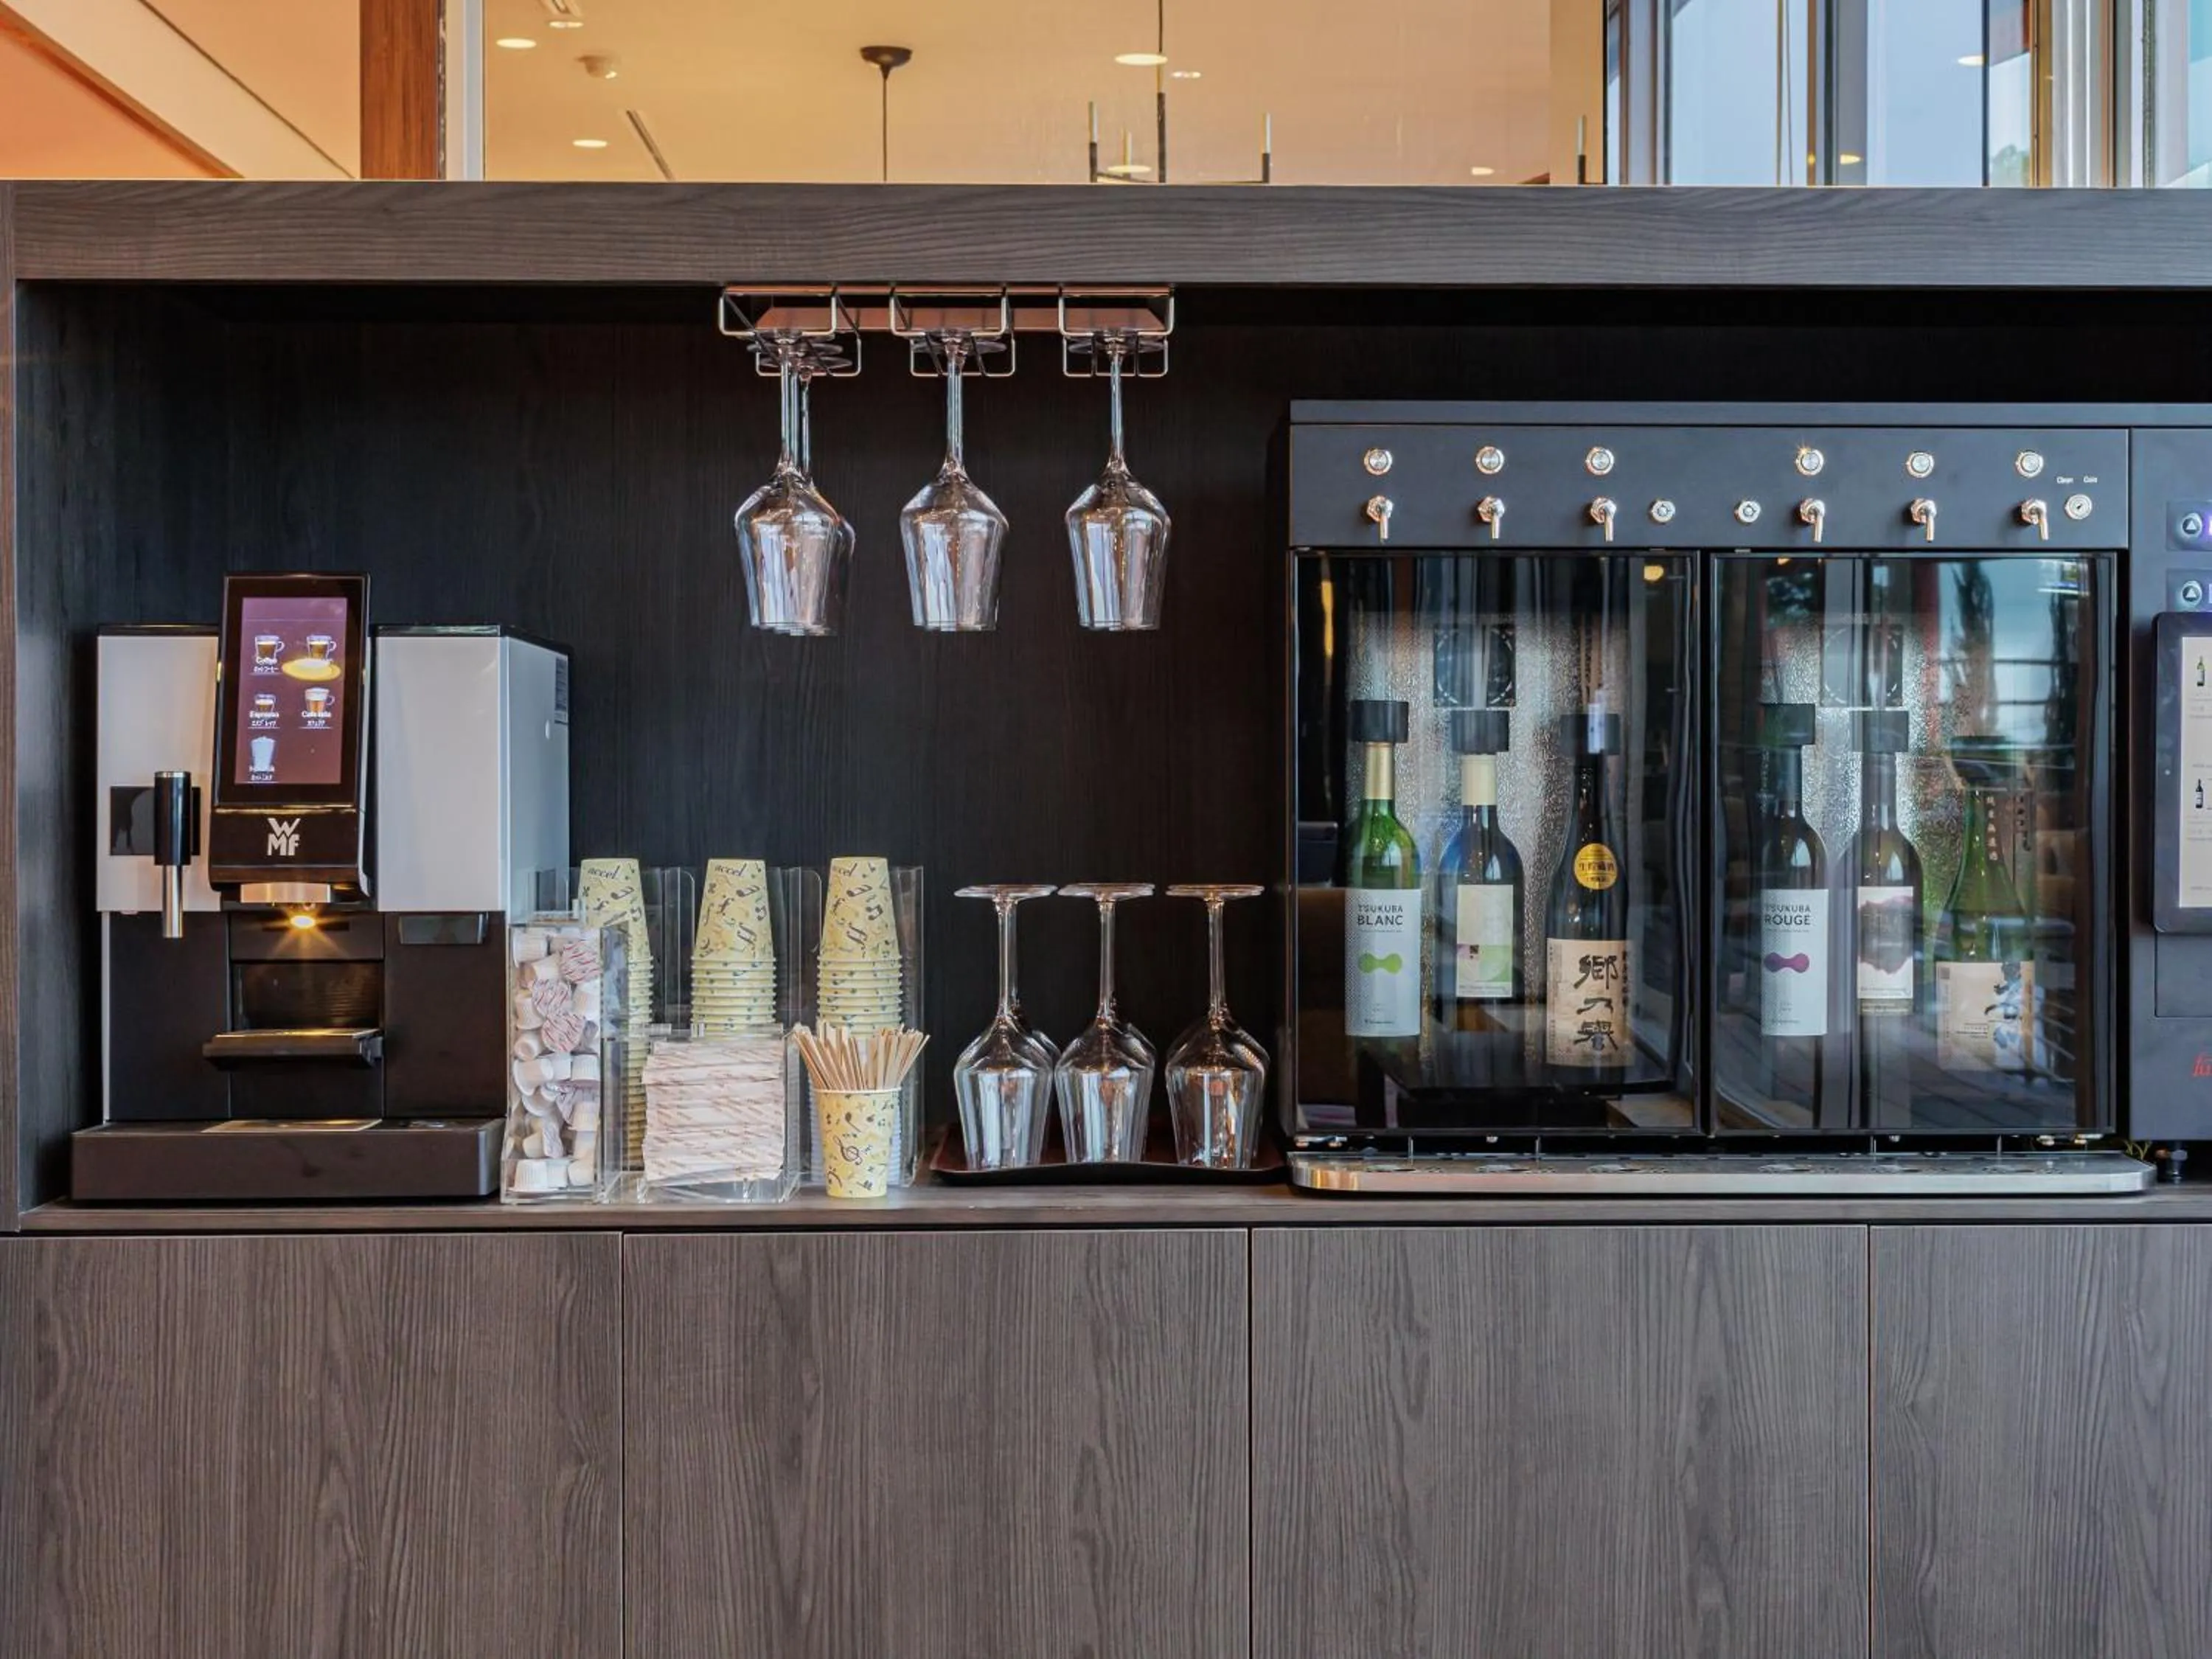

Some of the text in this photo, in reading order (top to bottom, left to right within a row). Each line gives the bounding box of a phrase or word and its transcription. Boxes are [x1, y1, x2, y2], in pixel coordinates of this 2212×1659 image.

[1357, 903, 1403, 914] TSUKUBA
[1764, 903, 1812, 913] TSUKUBA
[1357, 914, 1404, 926] BLANC
[1764, 914, 1812, 926] ROUGE
